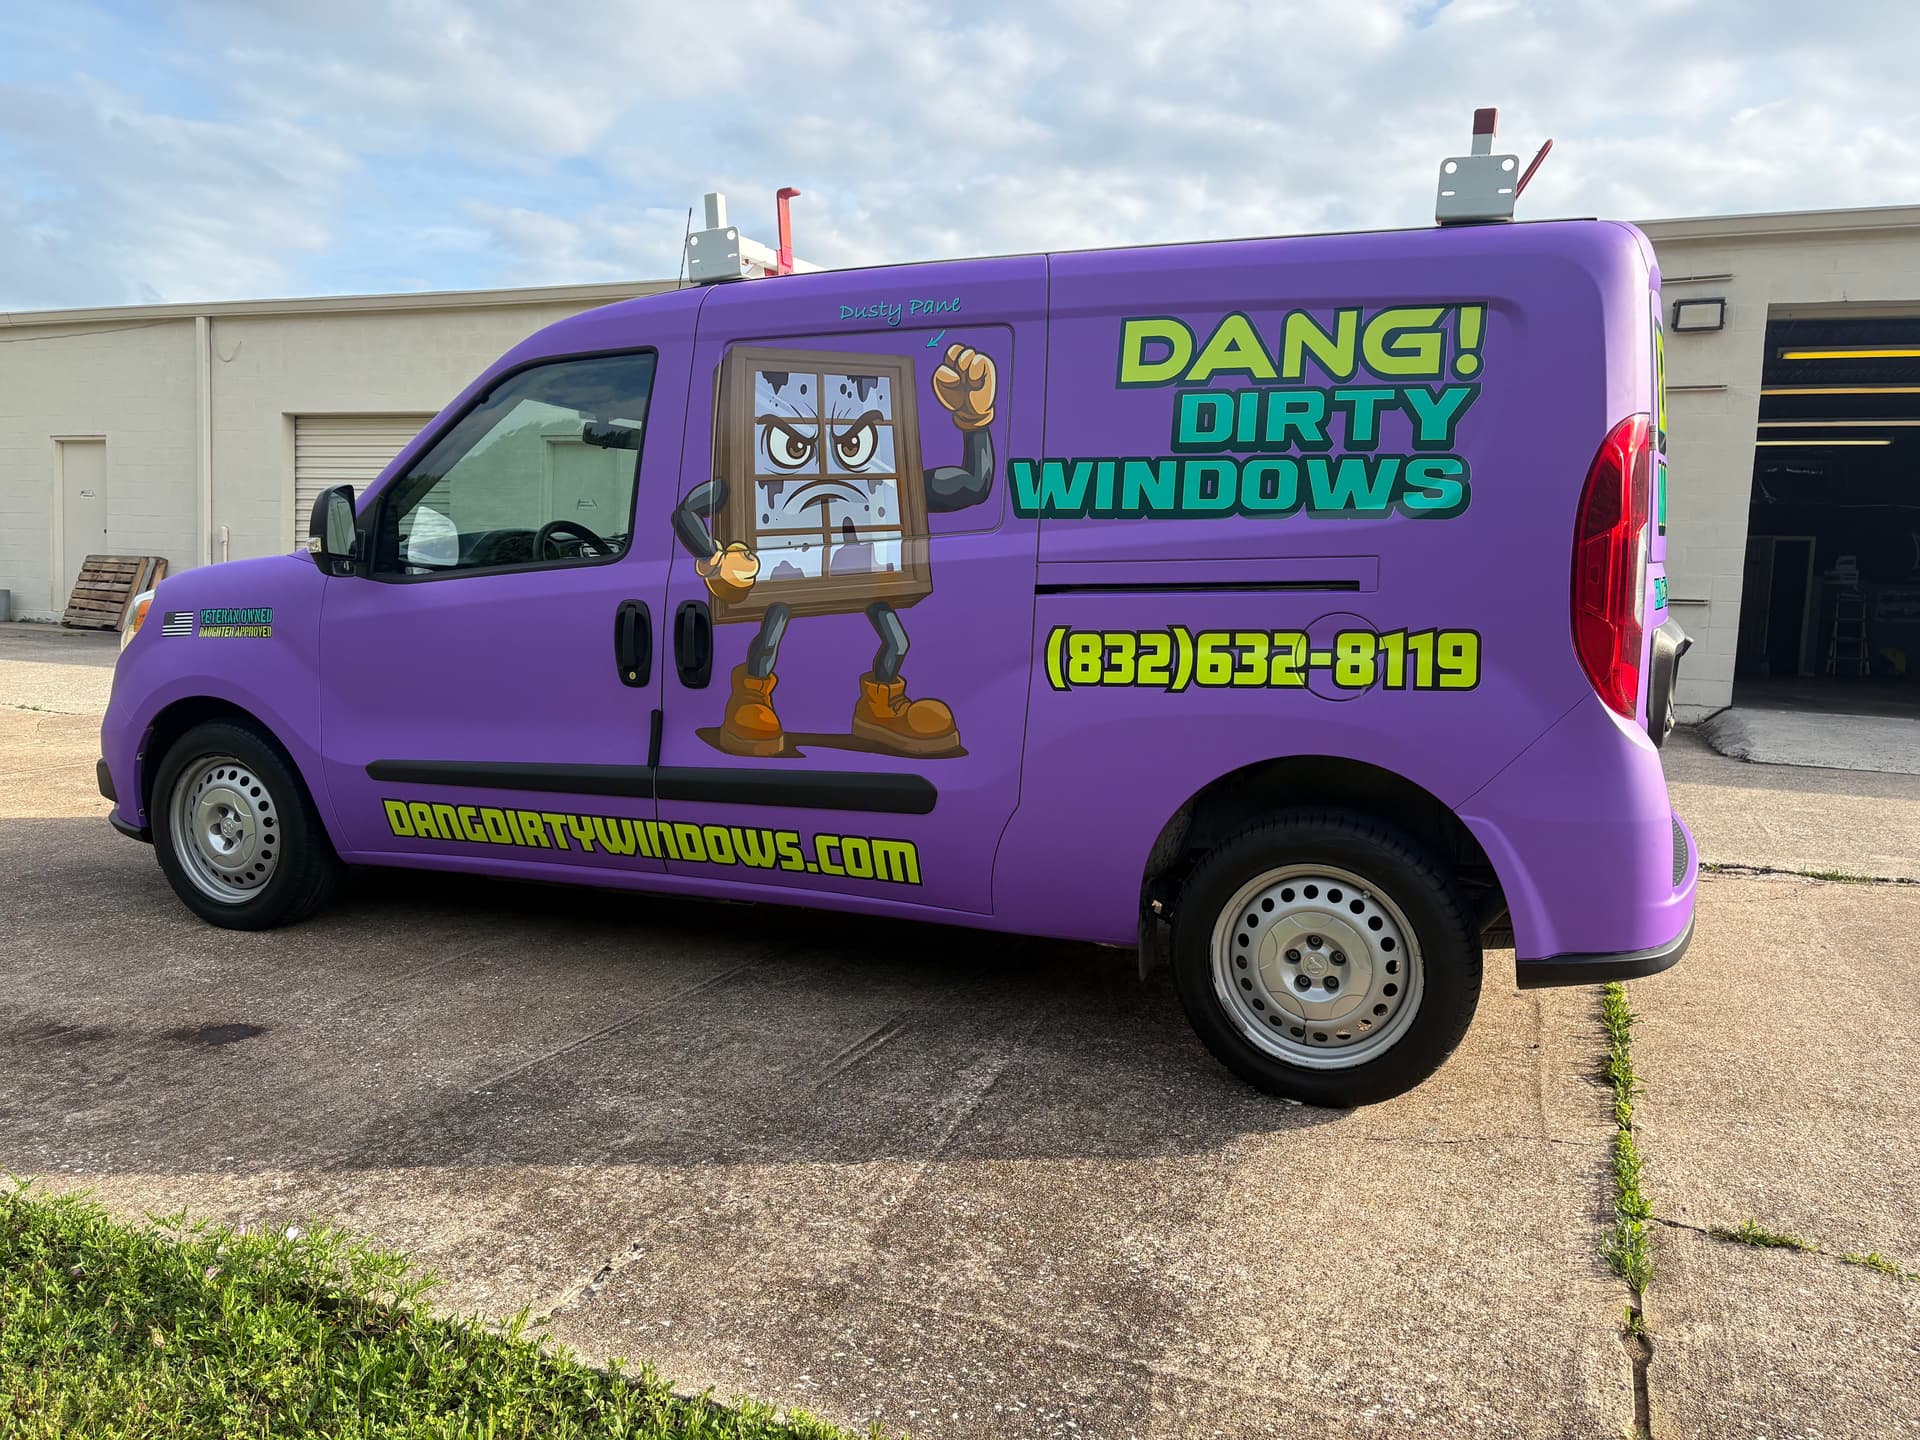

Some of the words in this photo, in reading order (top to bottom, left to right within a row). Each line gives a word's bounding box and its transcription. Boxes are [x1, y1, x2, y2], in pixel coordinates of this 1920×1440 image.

[839, 301, 902, 326] Dusty
[909, 297, 961, 315] Pane
[1118, 304, 1487, 386] DANG!
[1174, 385, 1477, 448] DIRTY
[1010, 456, 1469, 516] WINDOWS
[199, 626, 235, 638] DAUGHTER
[235, 625, 272, 638] APPROVED
[200, 609, 240, 624] VETERAN
[241, 608, 273, 623] OWNED
[1045, 626, 1480, 692] (832)632-8119
[383, 799, 922, 885] DANGDIRTYWINDOWS.COM
